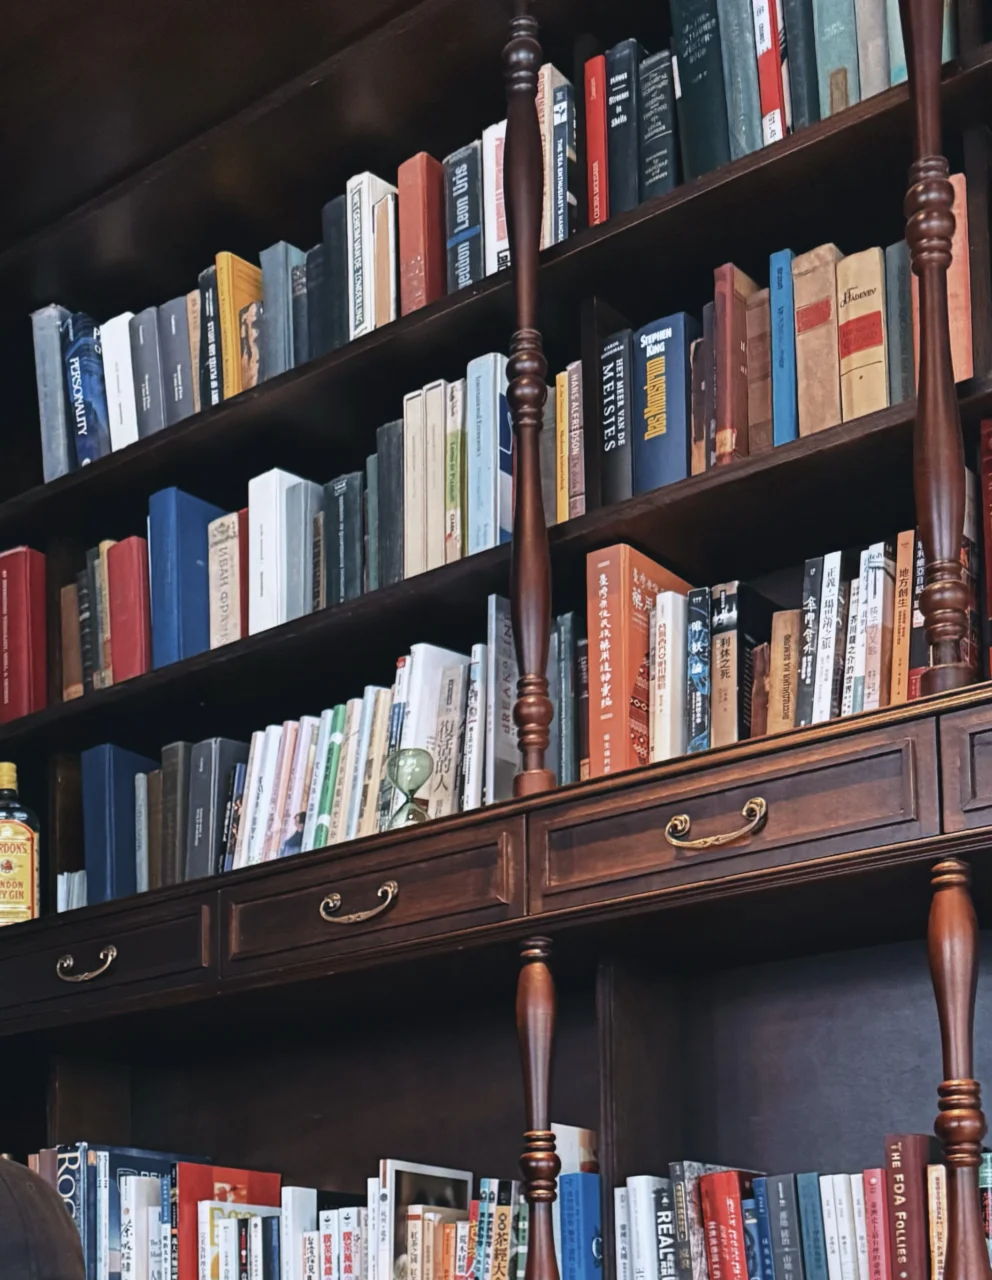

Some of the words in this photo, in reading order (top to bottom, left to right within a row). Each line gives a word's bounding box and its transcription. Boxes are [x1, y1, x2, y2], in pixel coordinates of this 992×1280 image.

[452, 164, 468, 196] Uris
[454, 196, 469, 233] Leon
[640, 327, 672, 349] STEPHEN
[646, 342, 665, 358] KING
[70, 357, 87, 435] PERSONALITY
[603, 363, 616, 452] MEISJES
[616, 379, 624, 407] MEER
[571, 402, 580, 456] ALFREDSON
[617, 408, 625, 430] VAN
[618, 432, 625, 446] DE
[218, 546, 229, 588] ИВАН
[898, 567, 909, 607] 地方創生
[720, 637, 731, 680] 利休之死
[434, 721, 454, 792] 復活的人
[9, 890, 24, 900] GIN
[890, 1143, 902, 1168] THE
[892, 1174, 905, 1206] FDA
[657, 1211, 674, 1260] REAL
